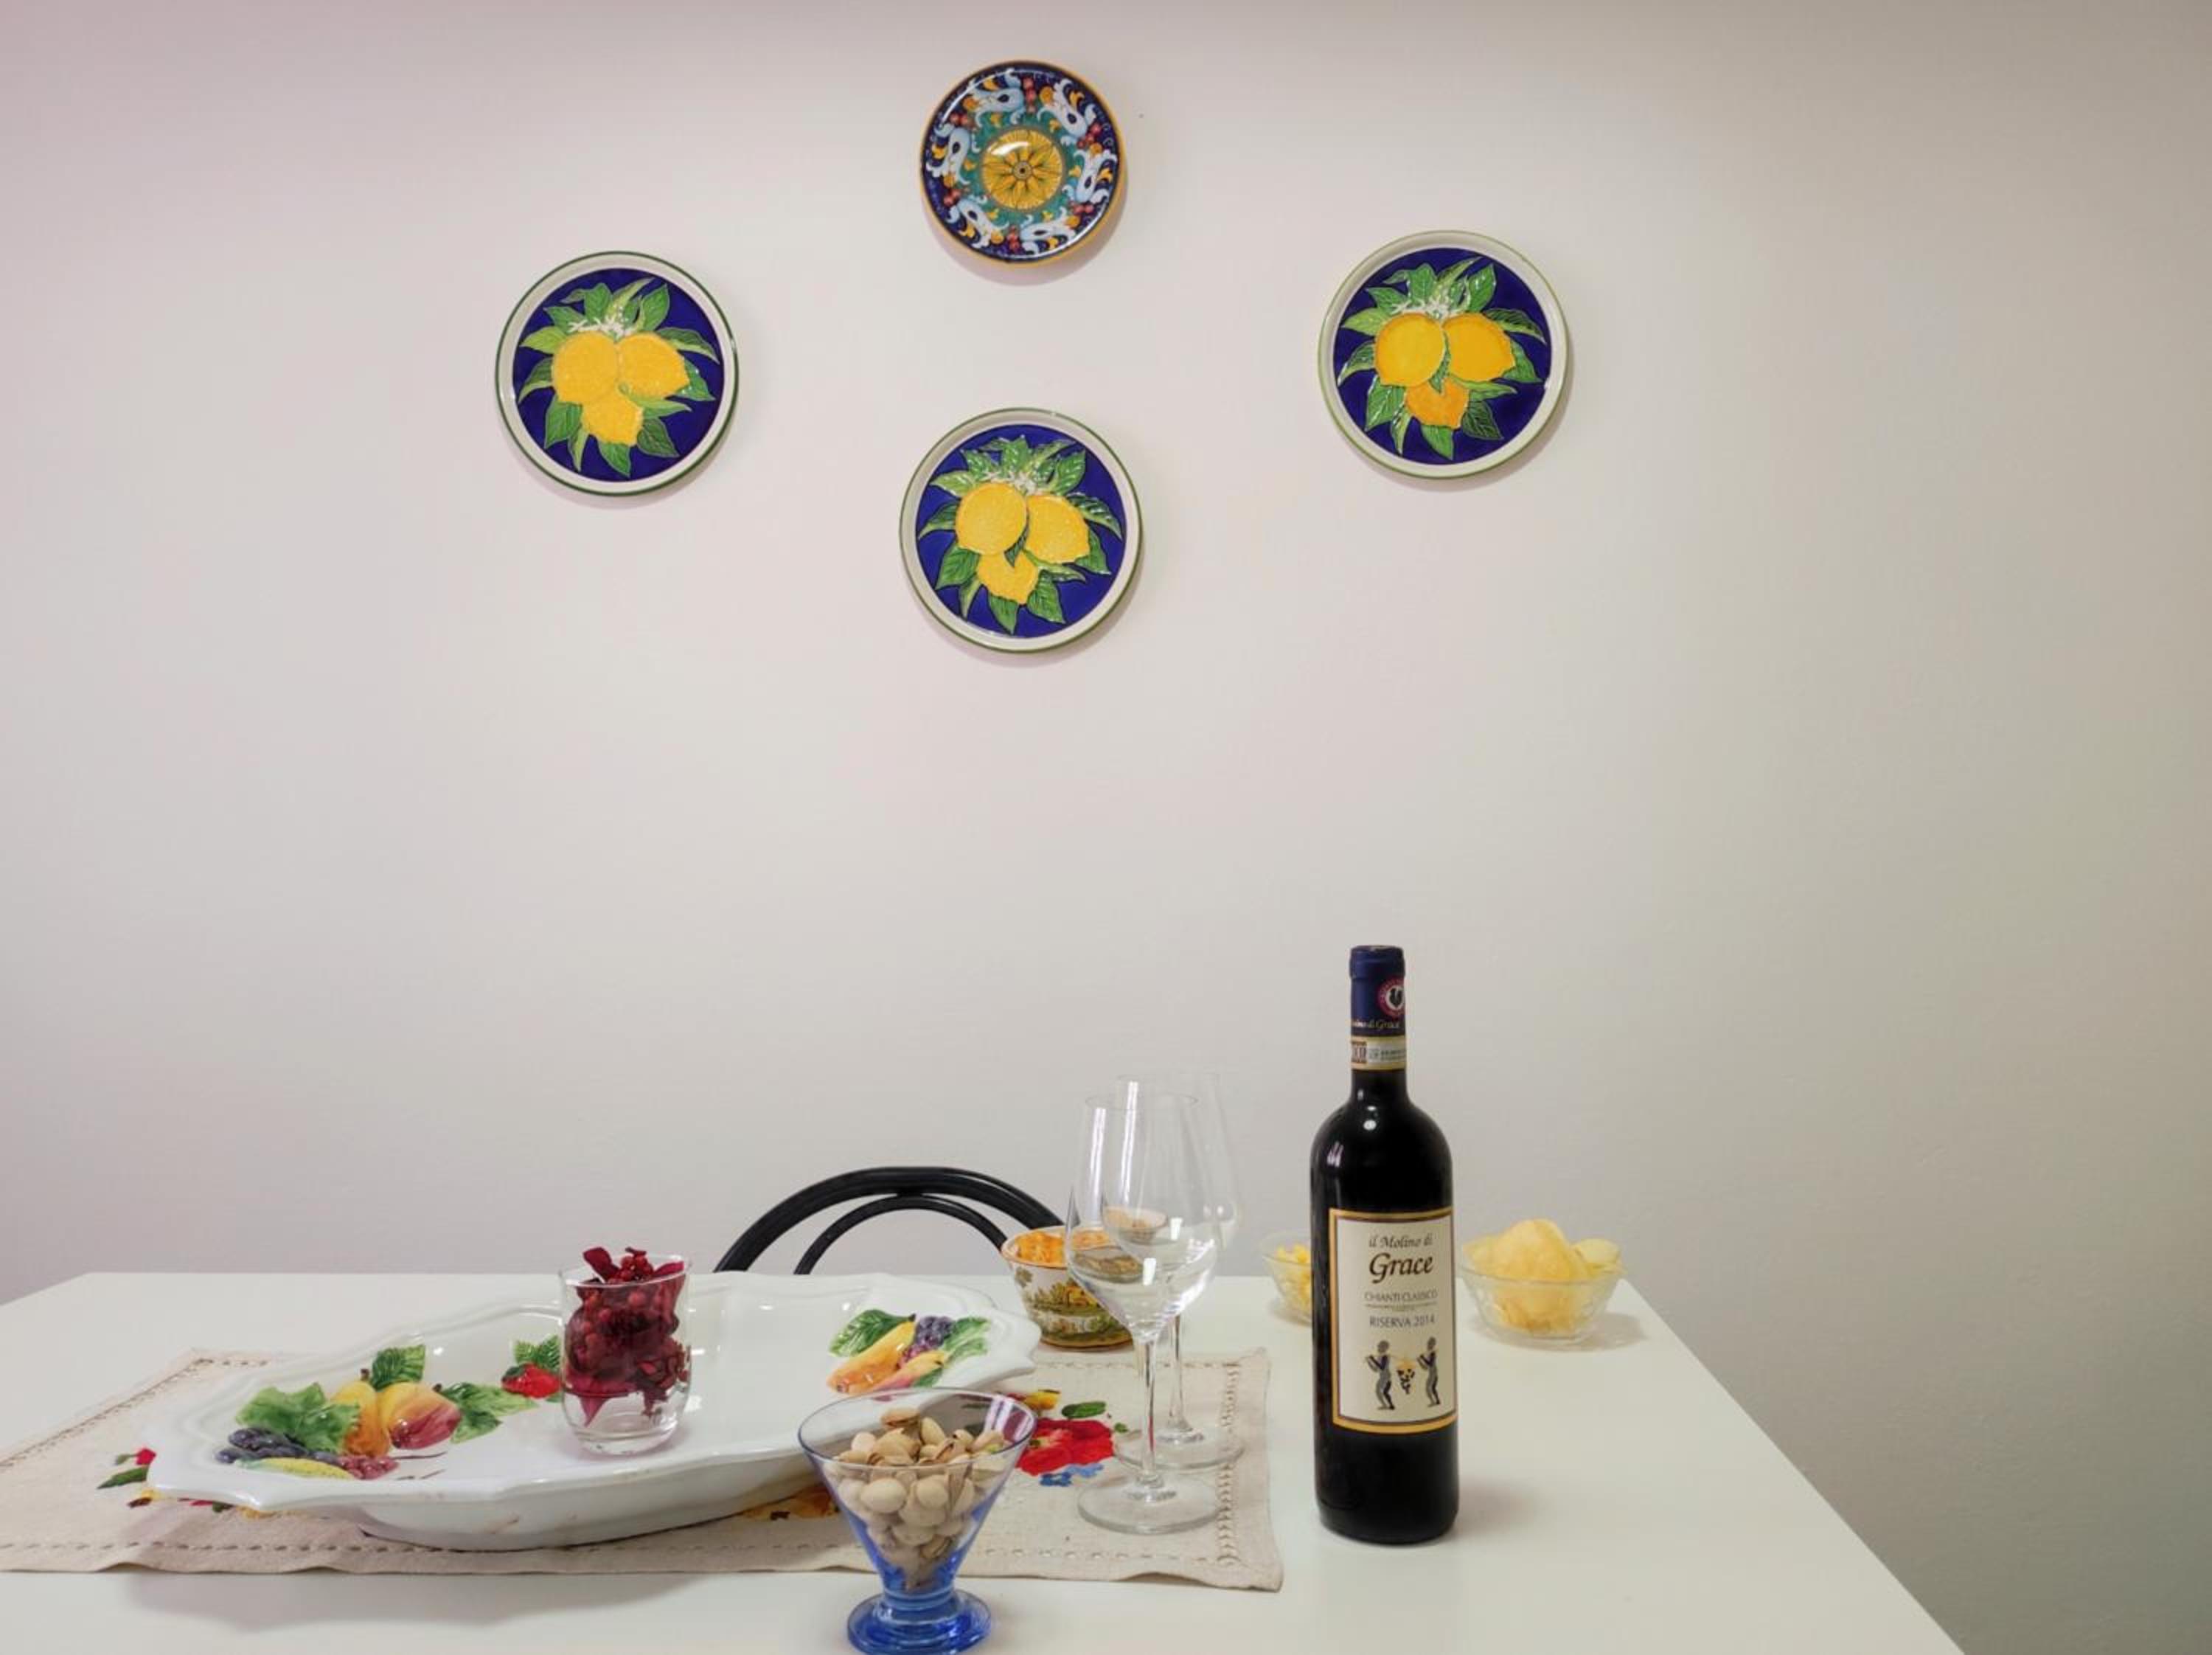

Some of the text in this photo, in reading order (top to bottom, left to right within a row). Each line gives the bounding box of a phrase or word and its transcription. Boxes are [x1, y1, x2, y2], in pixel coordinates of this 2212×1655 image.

[1380, 1235, 1422, 1248] Molino
[1424, 1233, 1433, 1246] di
[1369, 1252, 1433, 1284] Grace
[1365, 1291, 1438, 1302] CHIANTI CLASSICO
[1369, 1314, 1435, 1328] RISERVA 2014
